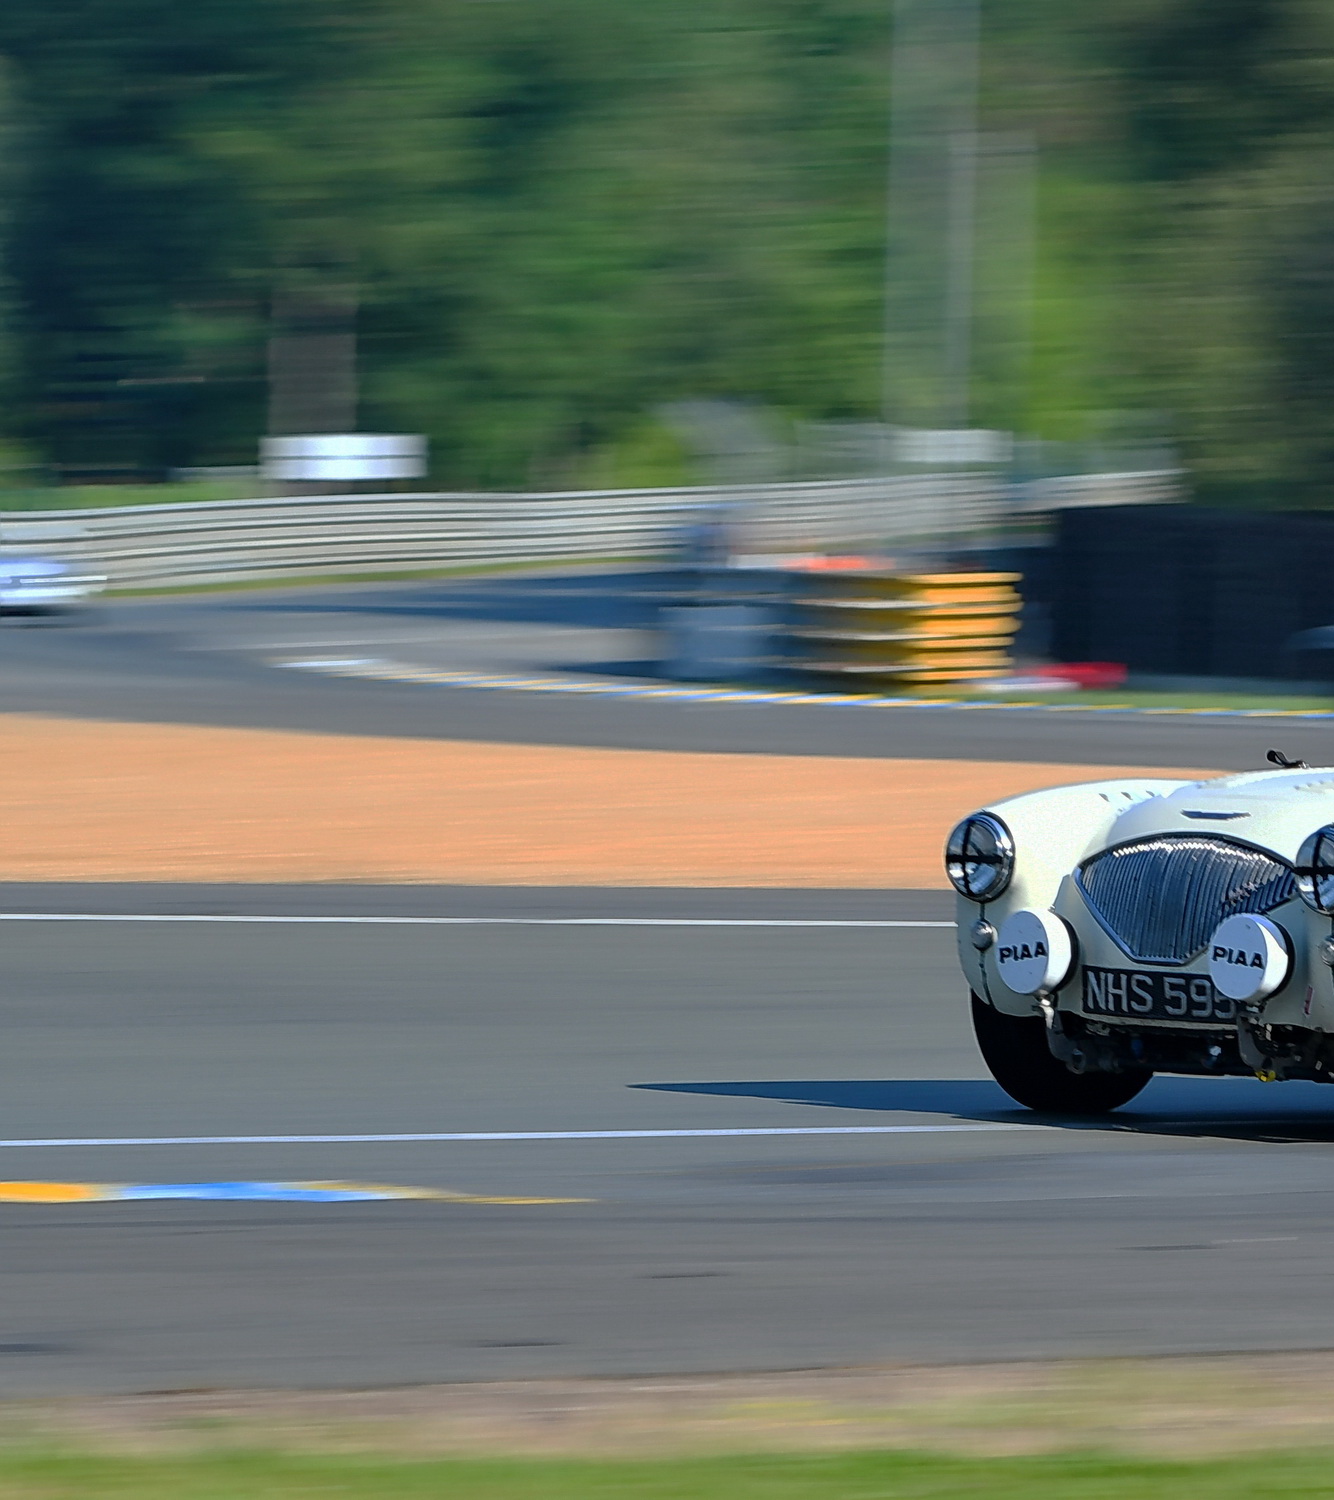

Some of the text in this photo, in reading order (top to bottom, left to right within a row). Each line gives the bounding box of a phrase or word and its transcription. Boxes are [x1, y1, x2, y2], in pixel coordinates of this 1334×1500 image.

[999, 941, 1048, 964] PIAA
[1213, 945, 1265, 970] PIAA
[1086, 970, 1154, 1013] NHS
